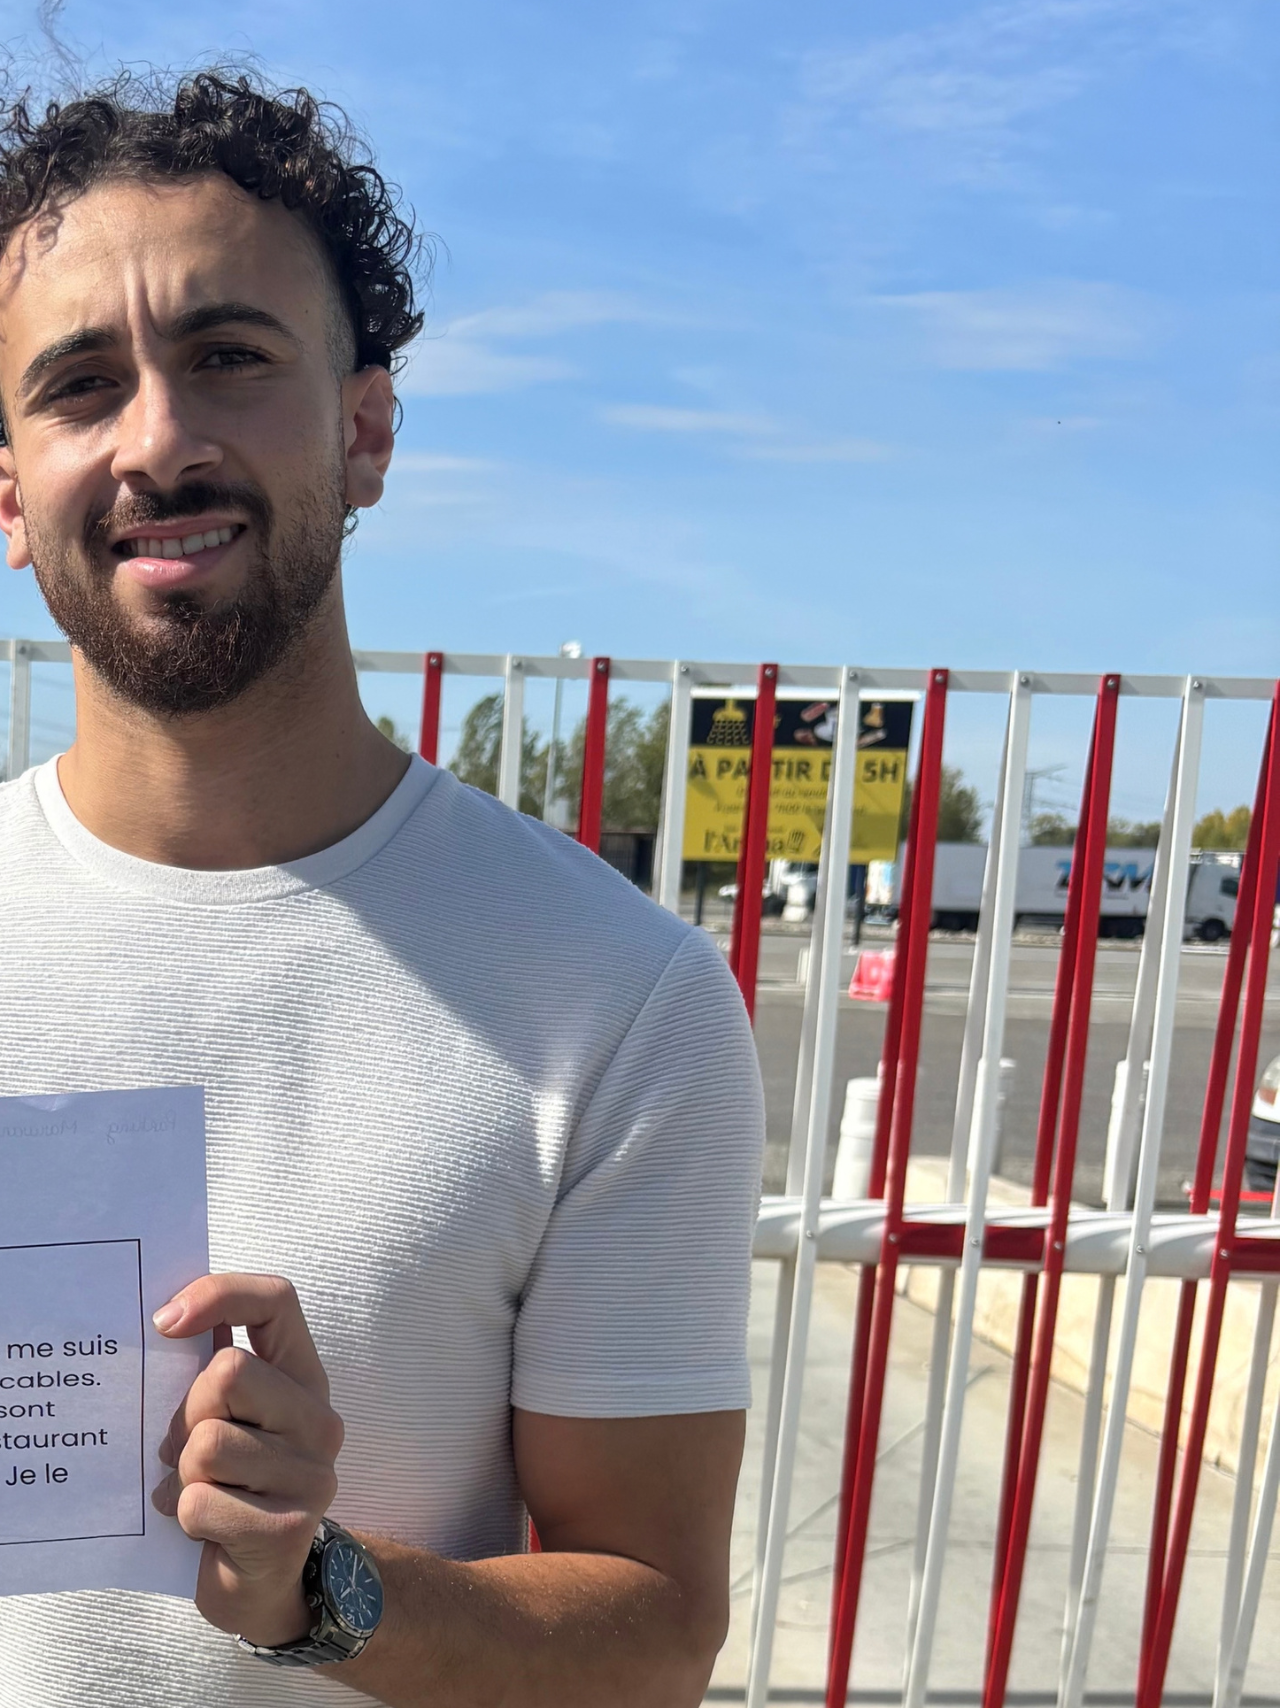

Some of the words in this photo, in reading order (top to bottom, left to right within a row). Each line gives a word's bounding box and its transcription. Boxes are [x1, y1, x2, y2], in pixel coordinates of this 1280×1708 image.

[716, 758, 811, 782] PATIR
[7, 1342, 54, 1360] me
[63, 1333, 118, 1357] suis
[5, 1465, 37, 1486] Je
[45, 1462, 69, 1484] le
